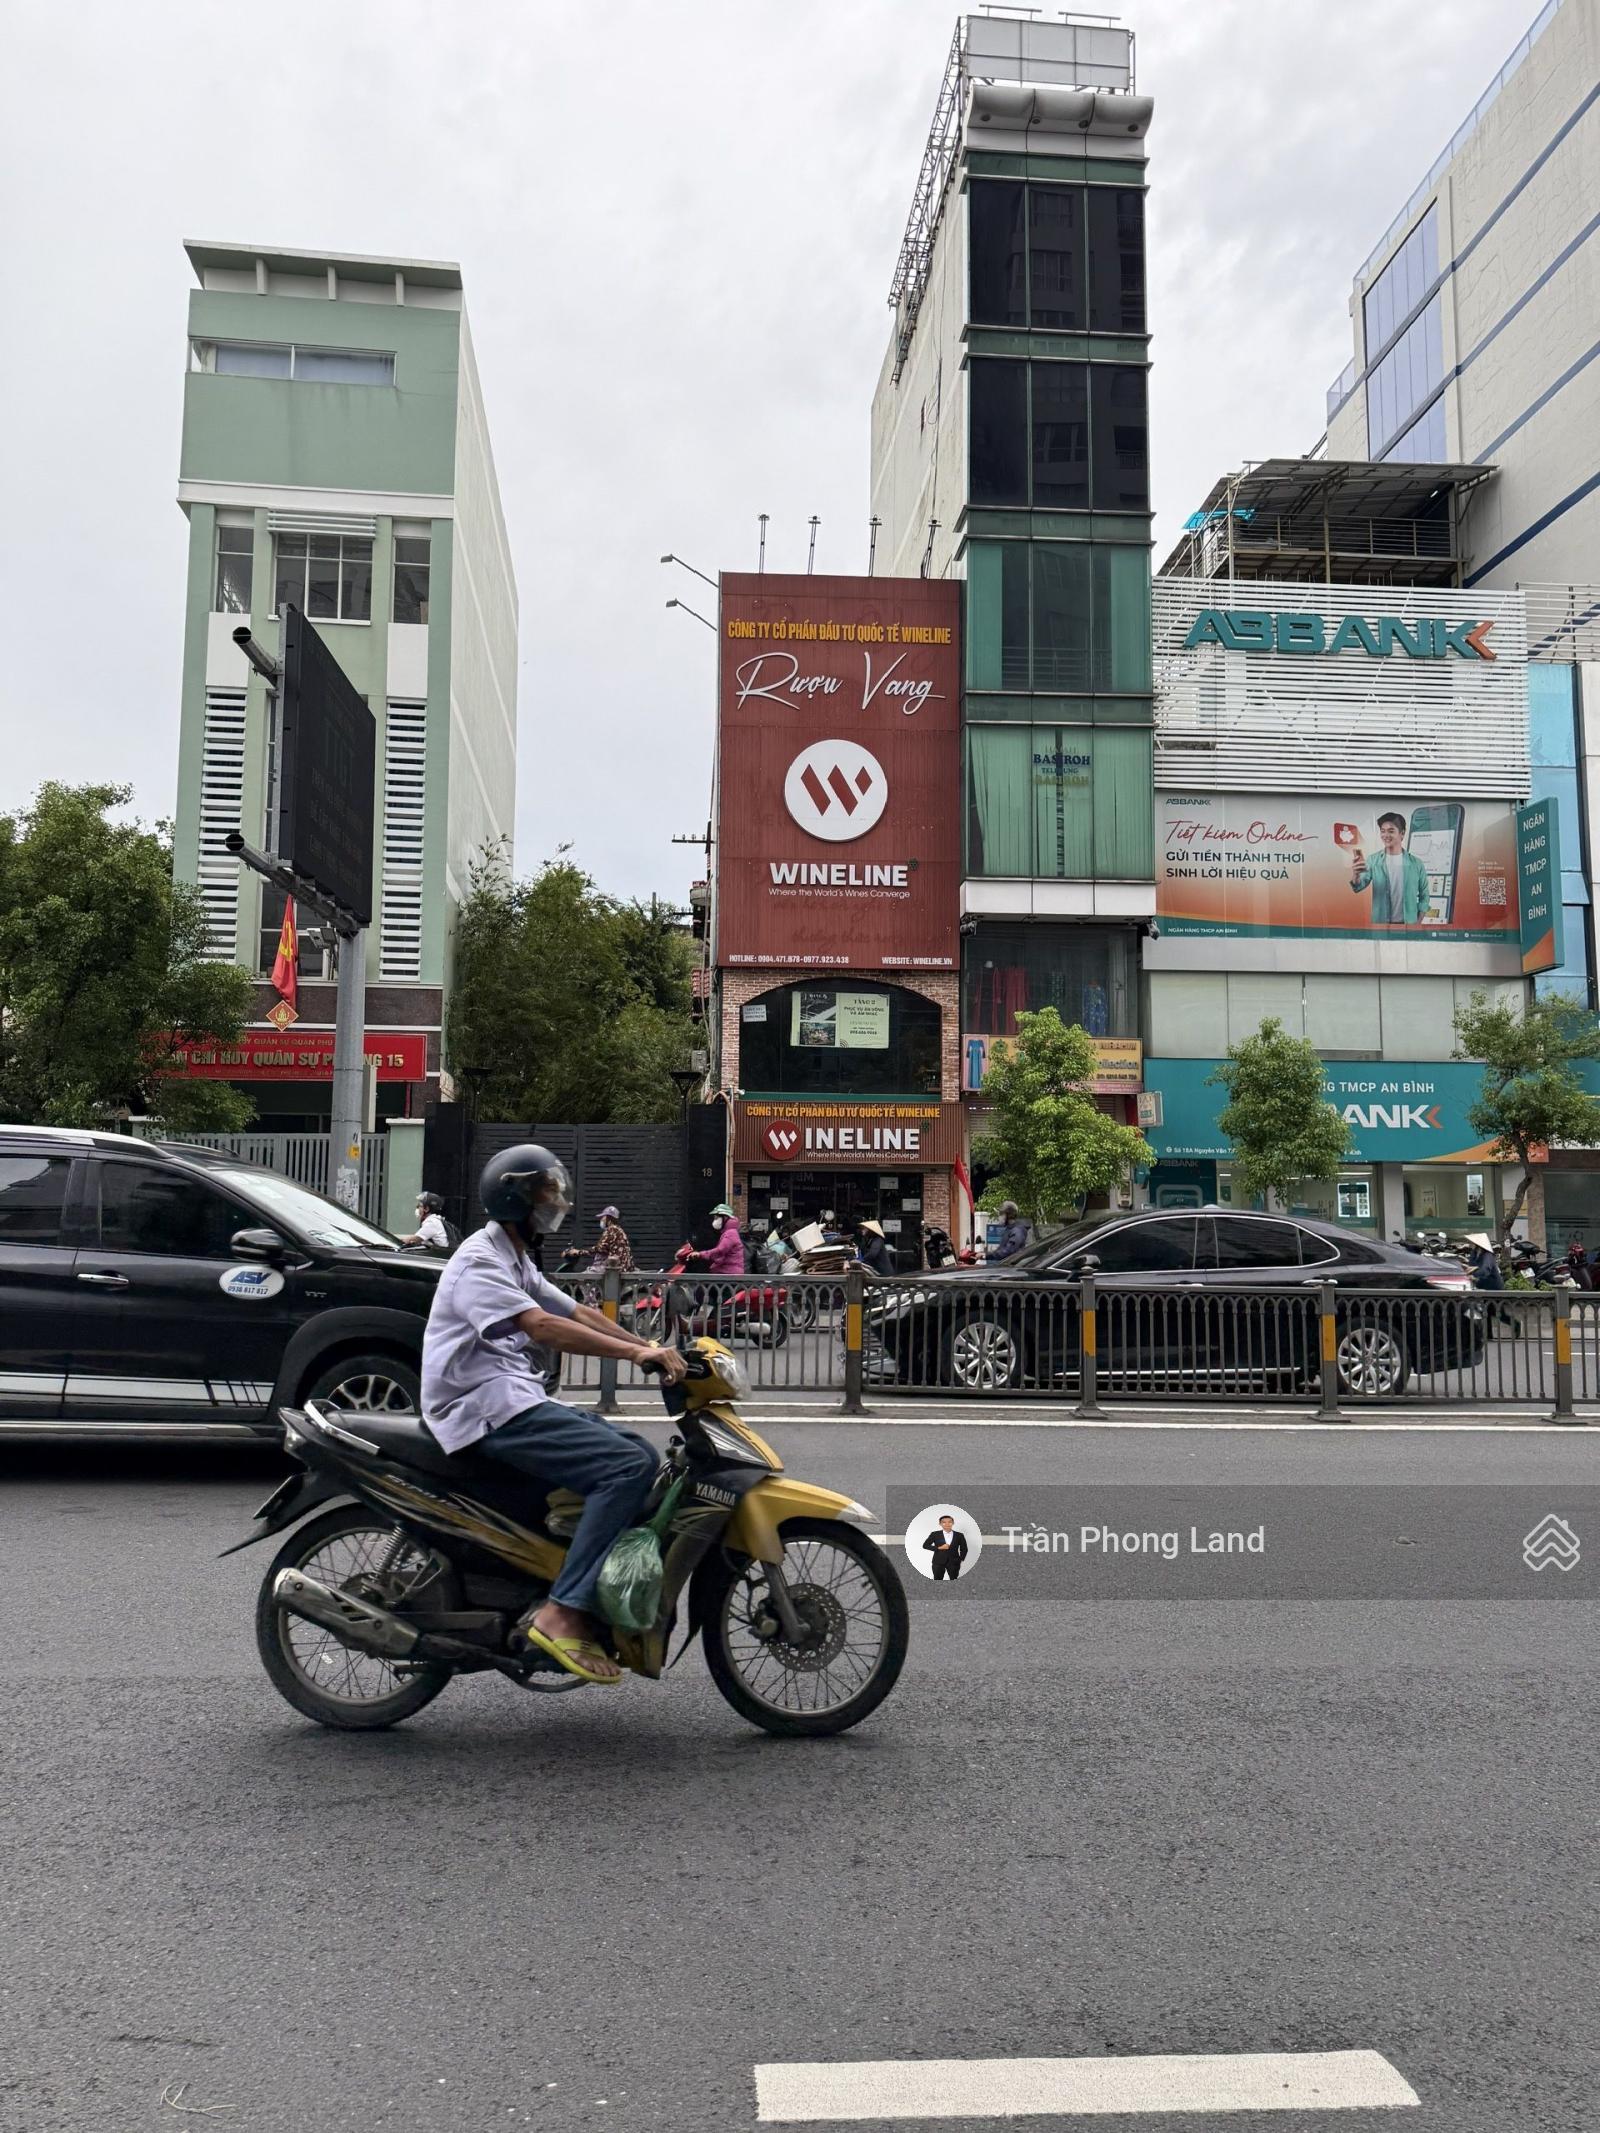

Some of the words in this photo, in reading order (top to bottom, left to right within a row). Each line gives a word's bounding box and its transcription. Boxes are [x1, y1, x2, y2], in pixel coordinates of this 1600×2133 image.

[728, 618, 756, 639] CÔNG
[757, 622, 770, 639] TY
[772, 616, 787, 639] CỔ
[842, 624, 856, 641] TƯ
[857, 621, 884, 643] QUỐC
[887, 622, 900, 643] TẾ
[901, 626, 951, 645] WINELINE
[1182, 608, 1484, 660] ABBANK
[735, 652, 844, 711] Rượu
[861, 651, 947, 715] Vang
[1523, 812, 1545, 832] NGÂN
[1165, 820, 1205, 845] Tiết
[1246, 820, 1319, 845] Online
[1524, 835, 1546, 854] HÀNG
[1166, 849, 1189, 862] GỬI
[1274, 853, 1305, 864] THƠI
[769, 862, 909, 887] WINELINE
[1166, 867, 1197, 878] SINH
[1201, 866, 1222, 879] LỜI
[1226, 868, 1257, 881] HIỆU
[1260, 867, 1289, 881] QUẢ
[1524, 857, 1547, 876] TMCP
[768, 887, 797, 897] Where
[799, 888, 812, 897] the
[844, 889, 868, 898] Wines
[870, 889, 911, 900] Converge
[1531, 882, 1542, 897] AN
[1528, 903, 1547, 920] BÌNH
[253, 1049, 295, 1067] QUÂN
[298, 1050, 321, 1069] SỰ
[386, 1054, 404, 1067] 15
[1339, 1081, 1376, 1093] TMCP
[1381, 1082, 1399, 1093] AN
[1403, 1080, 1435, 1093] BÌNH
[746, 1104, 771, 1116] CÔNG
[772, 1106, 785, 1117] TY
[785, 1102, 799, 1117] CỔ
[846, 1106, 858, 1118] TƯ
[859, 1103, 883, 1118] QUỐC
[883, 1104, 896, 1118] TẾ
[896, 1107, 941, 1118] WINELINE
[806, 1151, 830, 1159] Where
[830, 1151, 843, 1159] the
[865, 1152, 885, 1160] Wines
[885, 1152, 920, 1161] Converge
[702, 1167, 713, 1177] 18
[695, 1482, 736, 1506] YAMAHA
